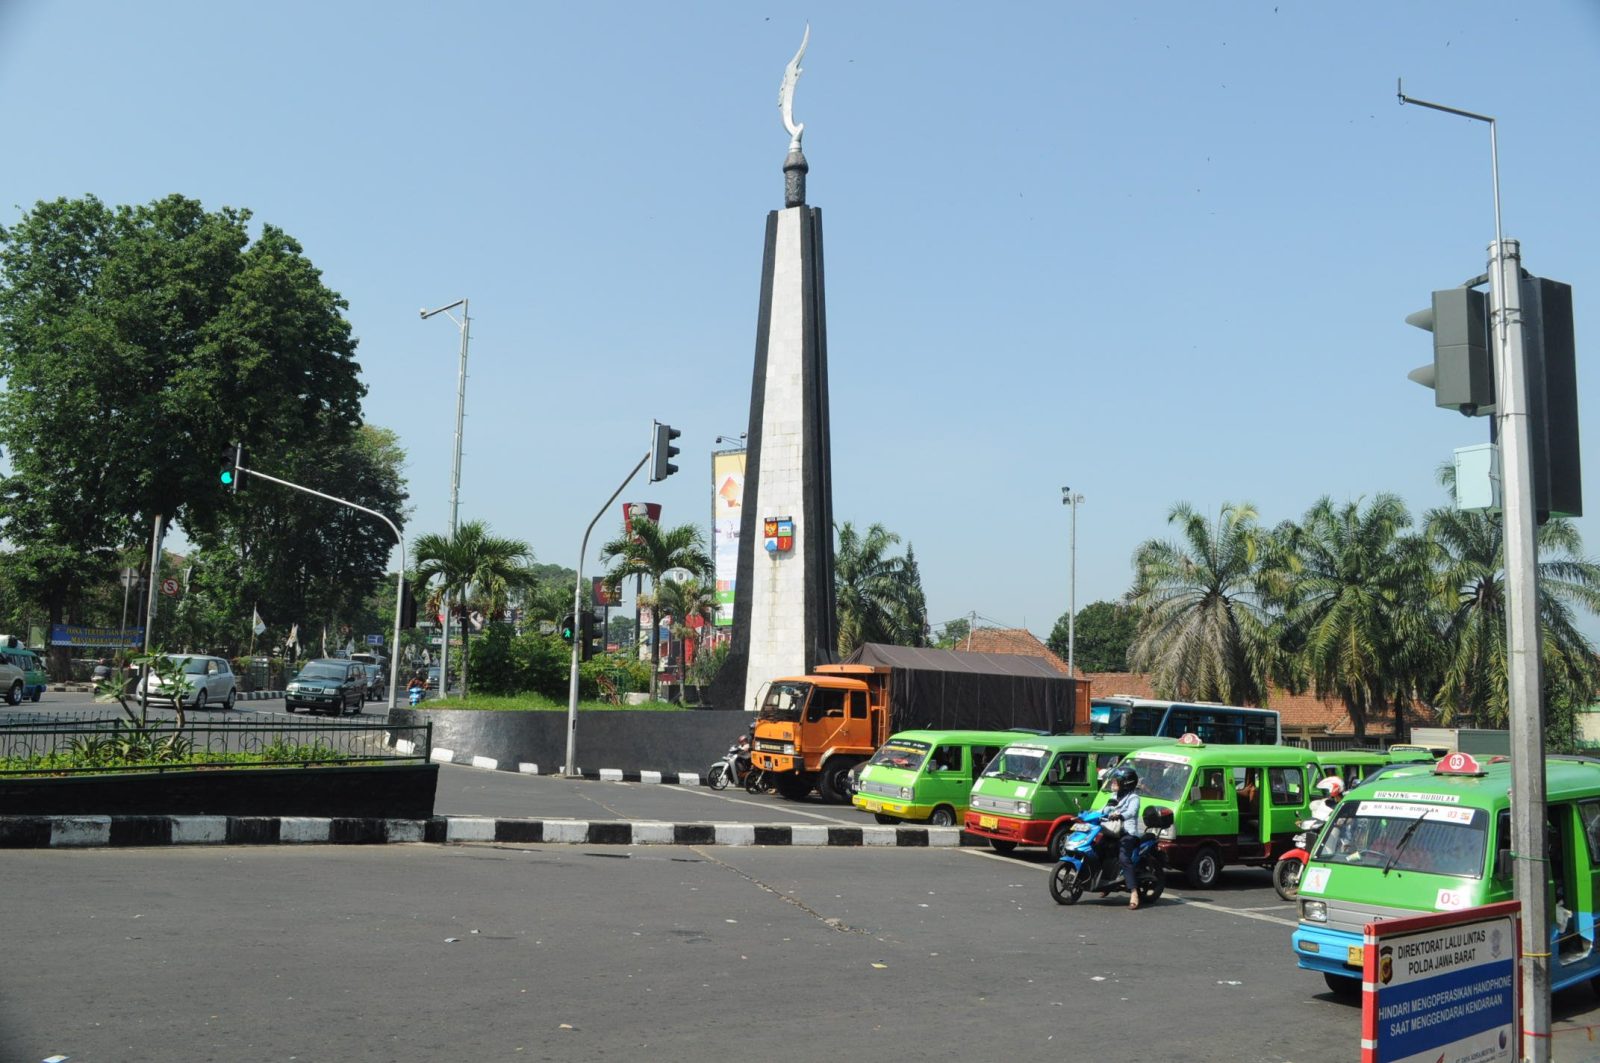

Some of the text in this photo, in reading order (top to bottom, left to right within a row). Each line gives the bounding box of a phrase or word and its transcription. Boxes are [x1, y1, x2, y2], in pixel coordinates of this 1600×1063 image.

[1451, 757, 1462, 767] 03
[1420, 793, 1456, 803] BUBULAK
[1440, 892, 1460, 906] 03
[1398, 930, 1486, 960] DIREKTORAT LALU LINTAS
[1409, 948, 1476, 975] POLDA JAWA BARAT
[1378, 975, 1511, 1020] HINDARI MENGOPERASIKAN HANDPHONE
[1390, 994, 1503, 1037] SAAT MENGGENDARAI KENDARAAN
